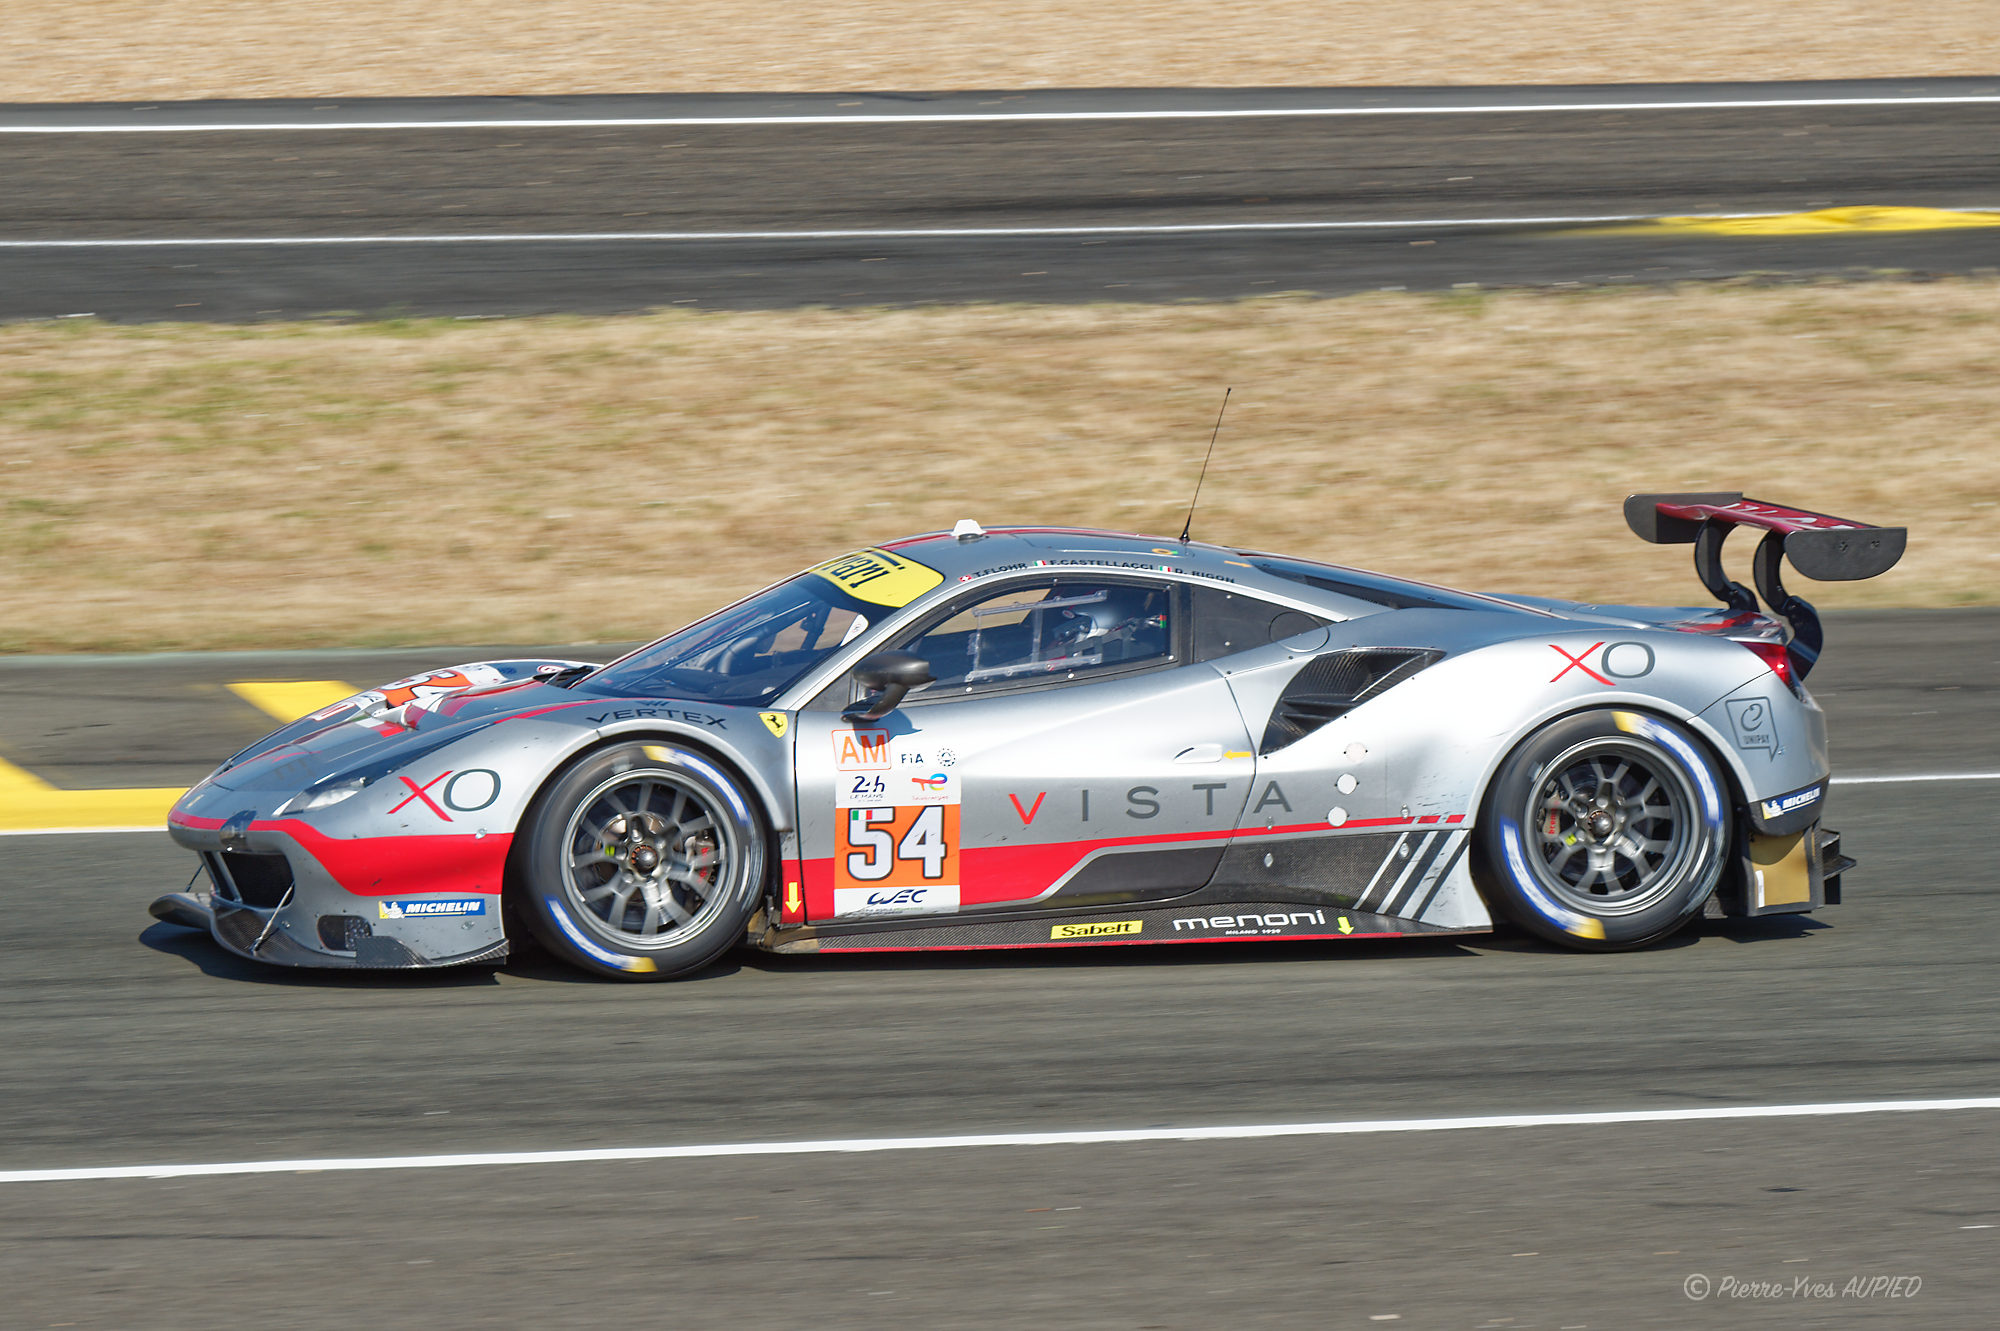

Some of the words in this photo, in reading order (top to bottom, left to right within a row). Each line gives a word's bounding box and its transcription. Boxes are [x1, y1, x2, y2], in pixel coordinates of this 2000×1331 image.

[974, 562, 1027, 577] T.FLOHR
[1548, 641, 1656, 686] XO
[586, 708, 728, 730] VERTEX
[841, 734, 887, 764] AM
[386, 768, 502, 822] XO
[1008, 780, 1293, 825] VISTA
[1782, 787, 1821, 809] MICHELIN
[847, 804, 948, 881] 54
[405, 901, 481, 914] MICHELIN
[867, 889, 928, 905] WEC
[1061, 923, 1134, 938] Sabelt
[1173, 910, 1326, 931] menoni
